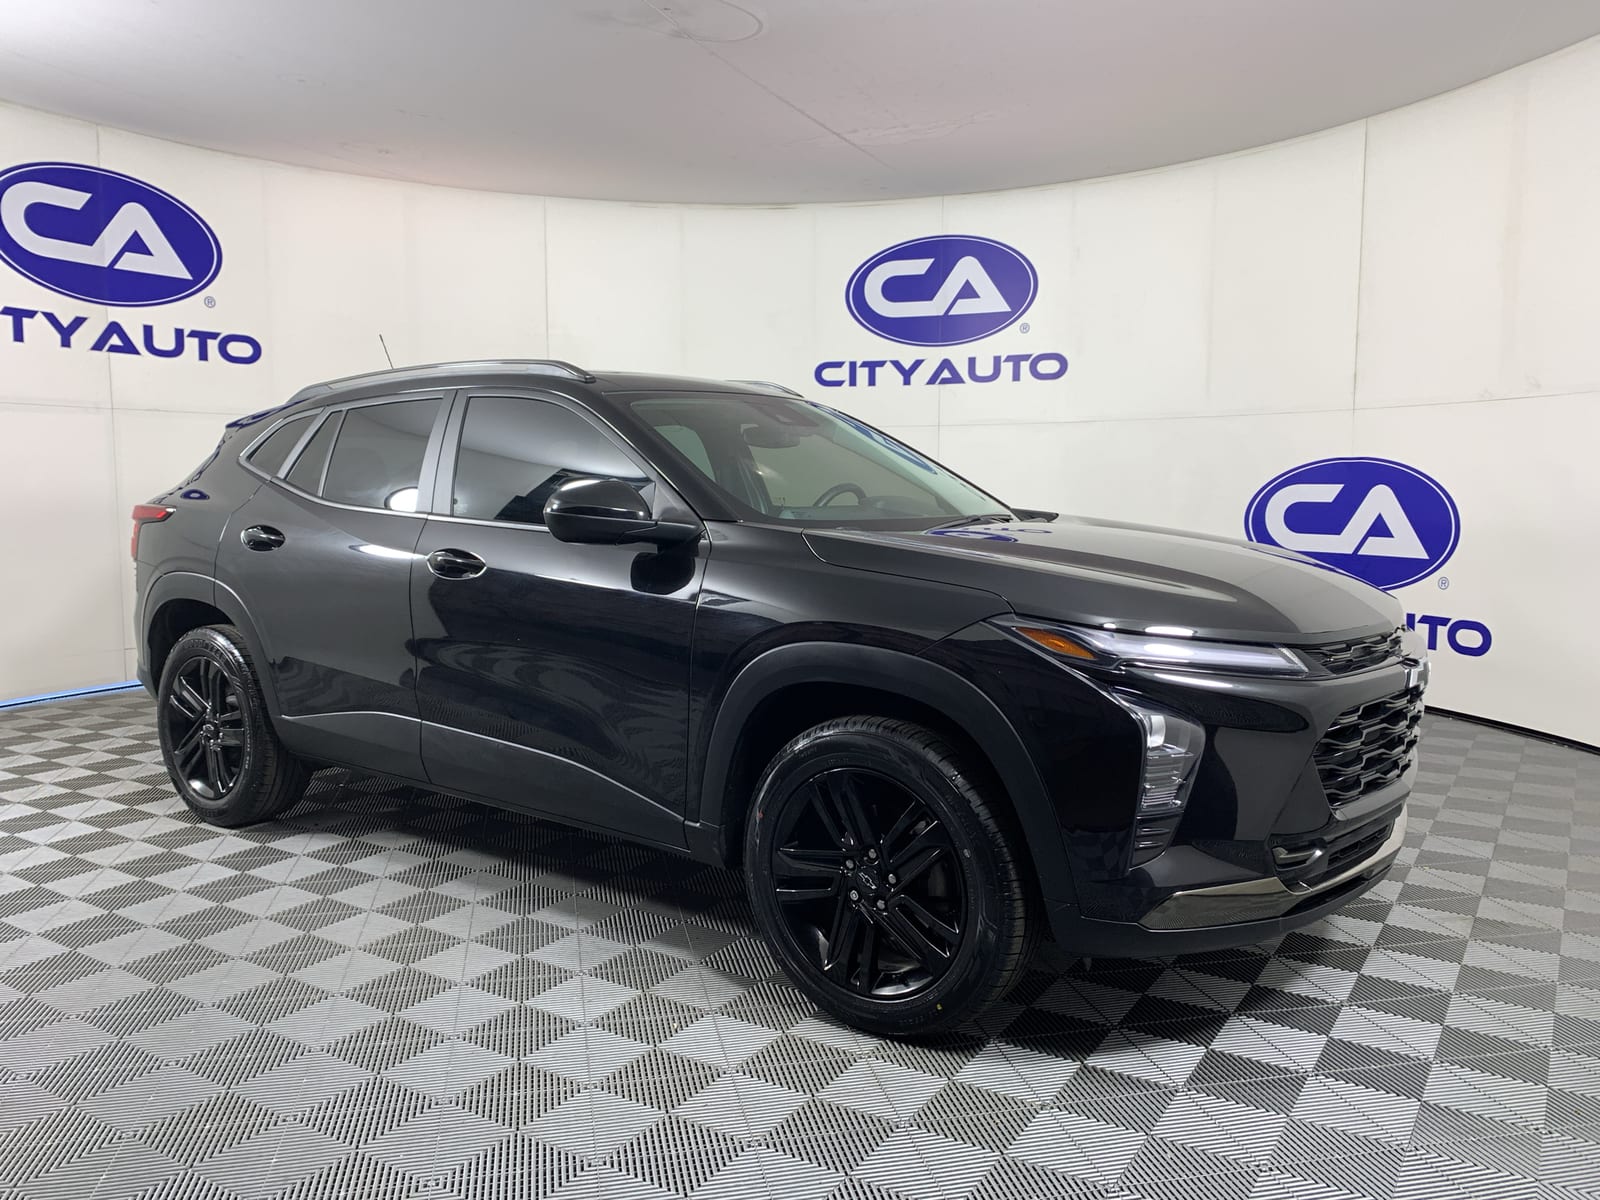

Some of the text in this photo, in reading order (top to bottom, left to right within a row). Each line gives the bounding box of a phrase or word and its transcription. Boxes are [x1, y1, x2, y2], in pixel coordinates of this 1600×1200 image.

[1, 181, 194, 280] CA
[864, 255, 1012, 318] CA
[0, 305, 262, 364] TY AUTO
[814, 352, 1069, 387] CITY AUTO
[1265, 483, 1430, 560] CA
